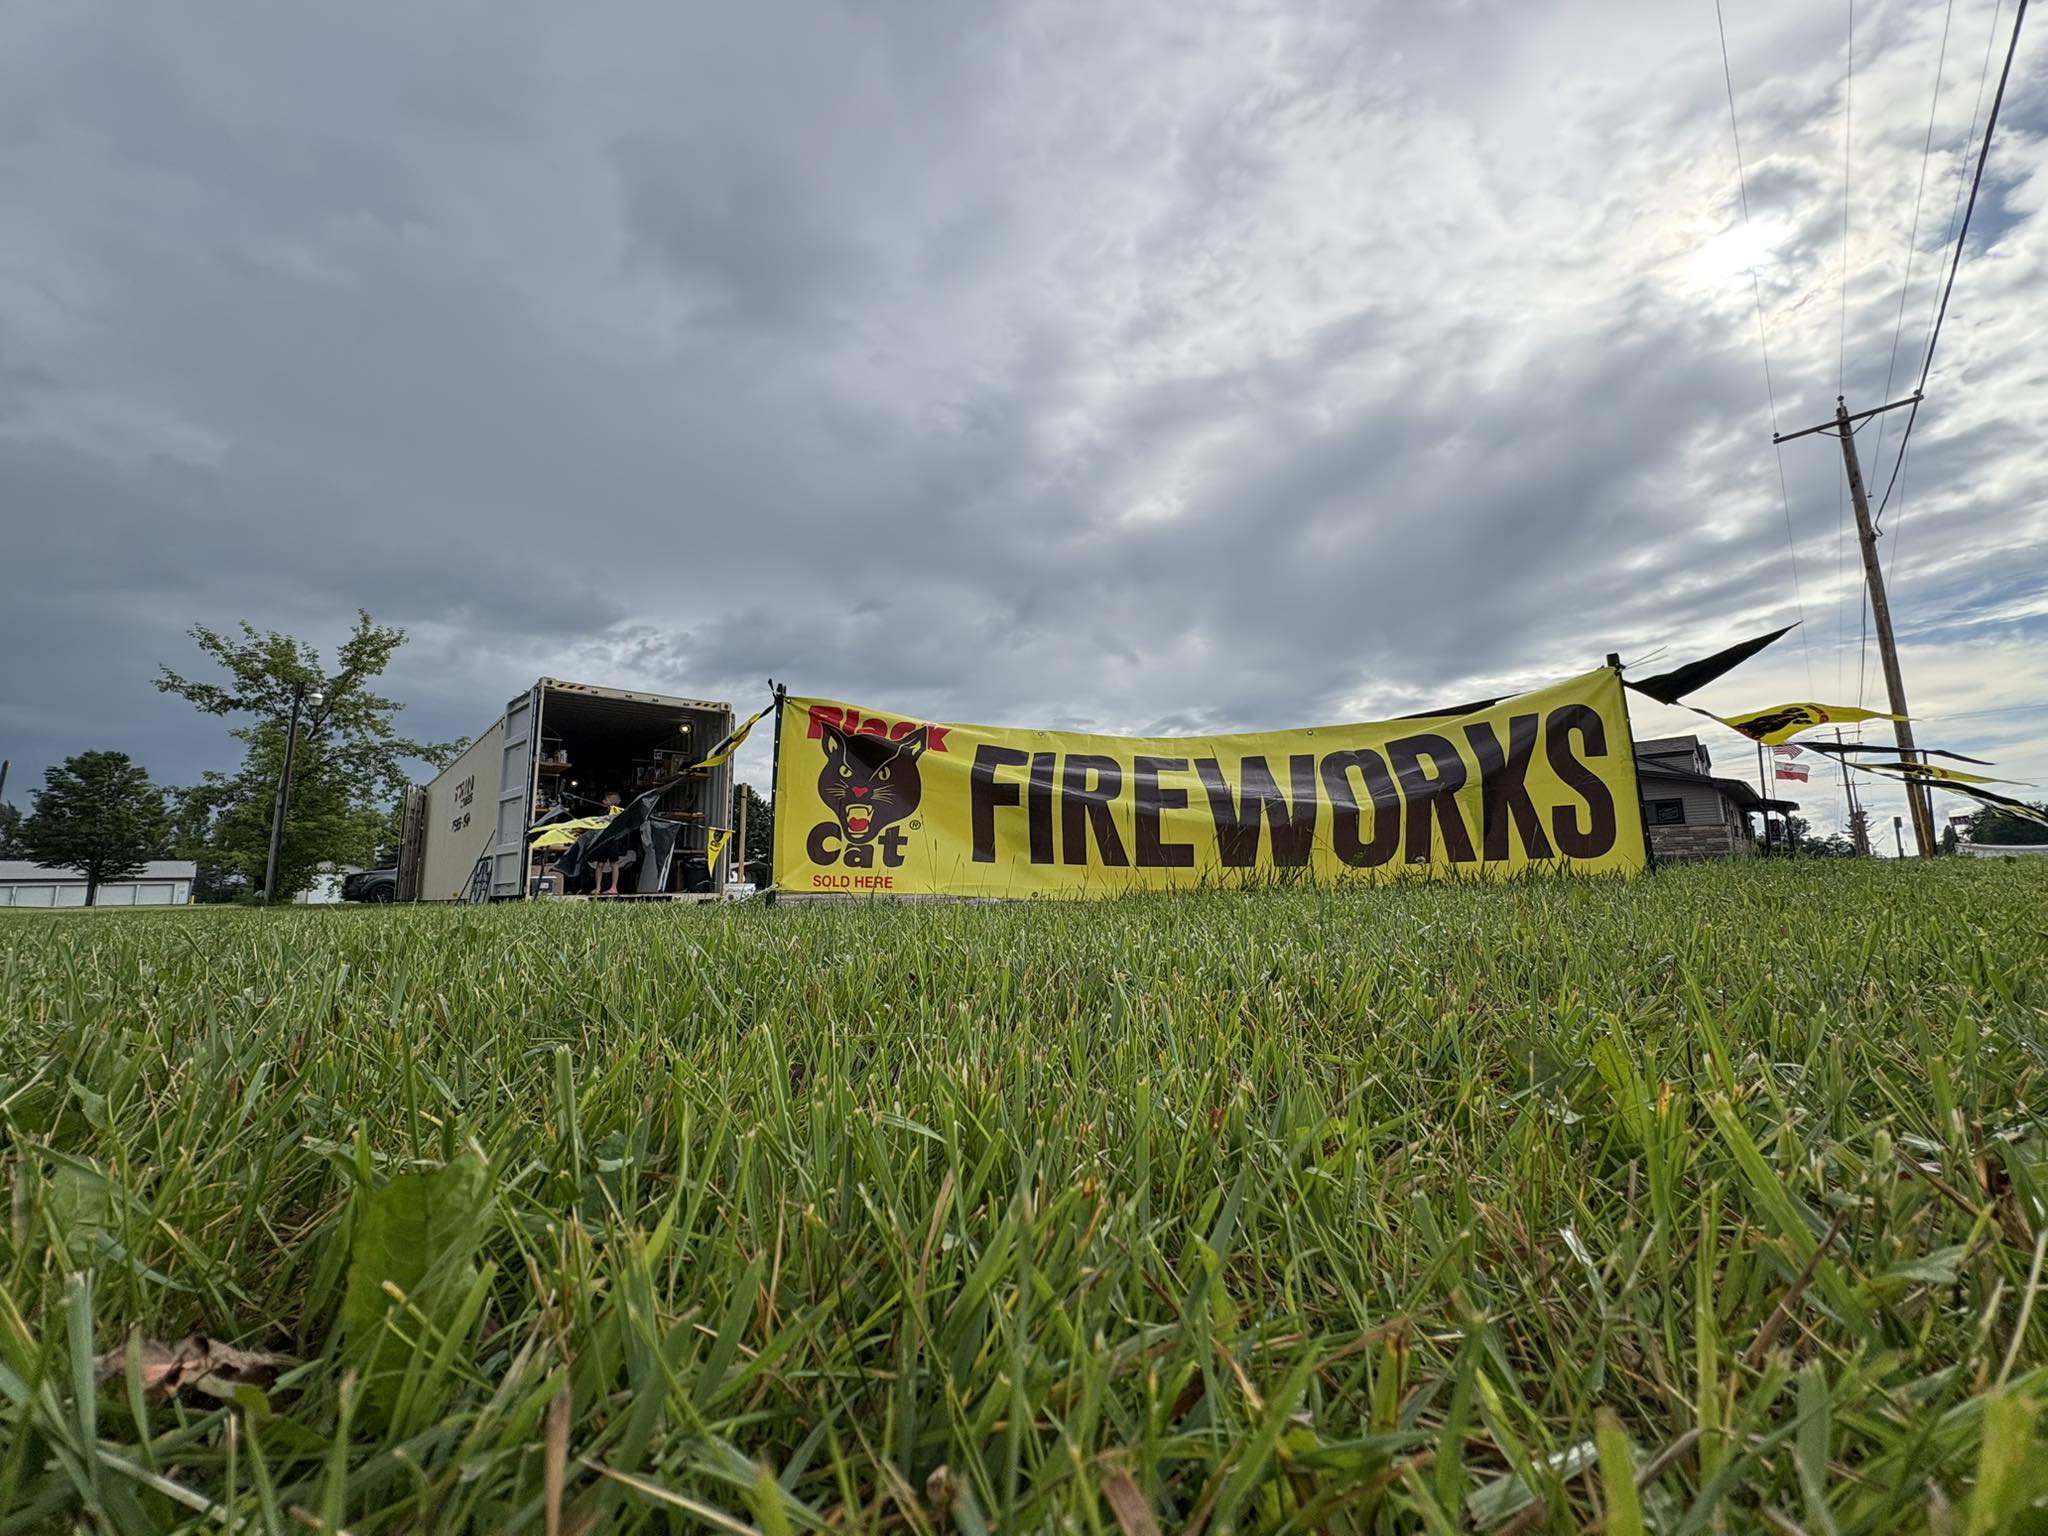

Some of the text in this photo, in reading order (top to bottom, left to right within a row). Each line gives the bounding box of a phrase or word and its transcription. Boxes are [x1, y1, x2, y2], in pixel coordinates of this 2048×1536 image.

[971, 703, 1616, 868] FIREWORKS
[813, 875, 893, 889] SOLD HERE
